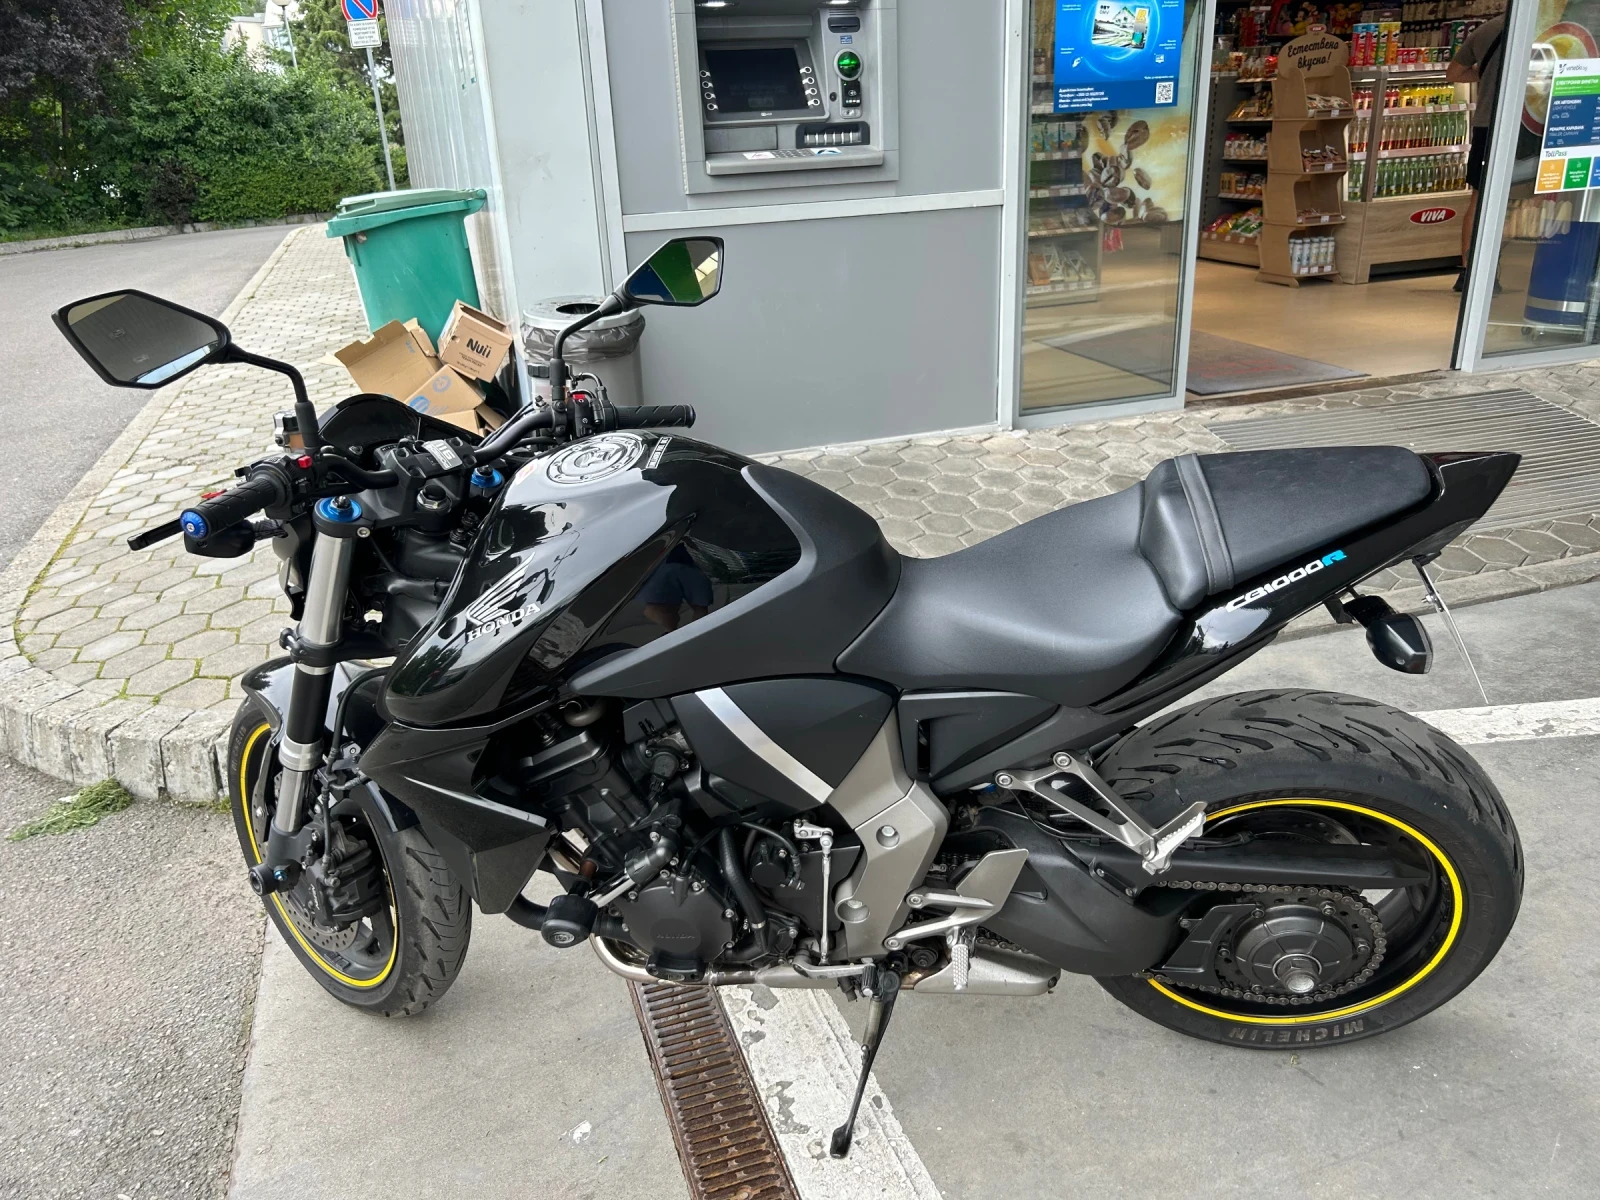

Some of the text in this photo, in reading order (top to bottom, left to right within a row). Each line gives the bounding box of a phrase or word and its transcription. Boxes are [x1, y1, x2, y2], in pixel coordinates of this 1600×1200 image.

[1287, 37, 1339, 58] Естествено
[1297, 51, 1332, 71] вкусно!
[1545, 150, 1568, 158] TollPass
[1420, 209, 1447, 223] VIVA
[1224, 550, 1347, 613] CB1000R
[466, 602, 541, 643] HONDA
[1228, 1018, 1364, 1043] MICHELIN
